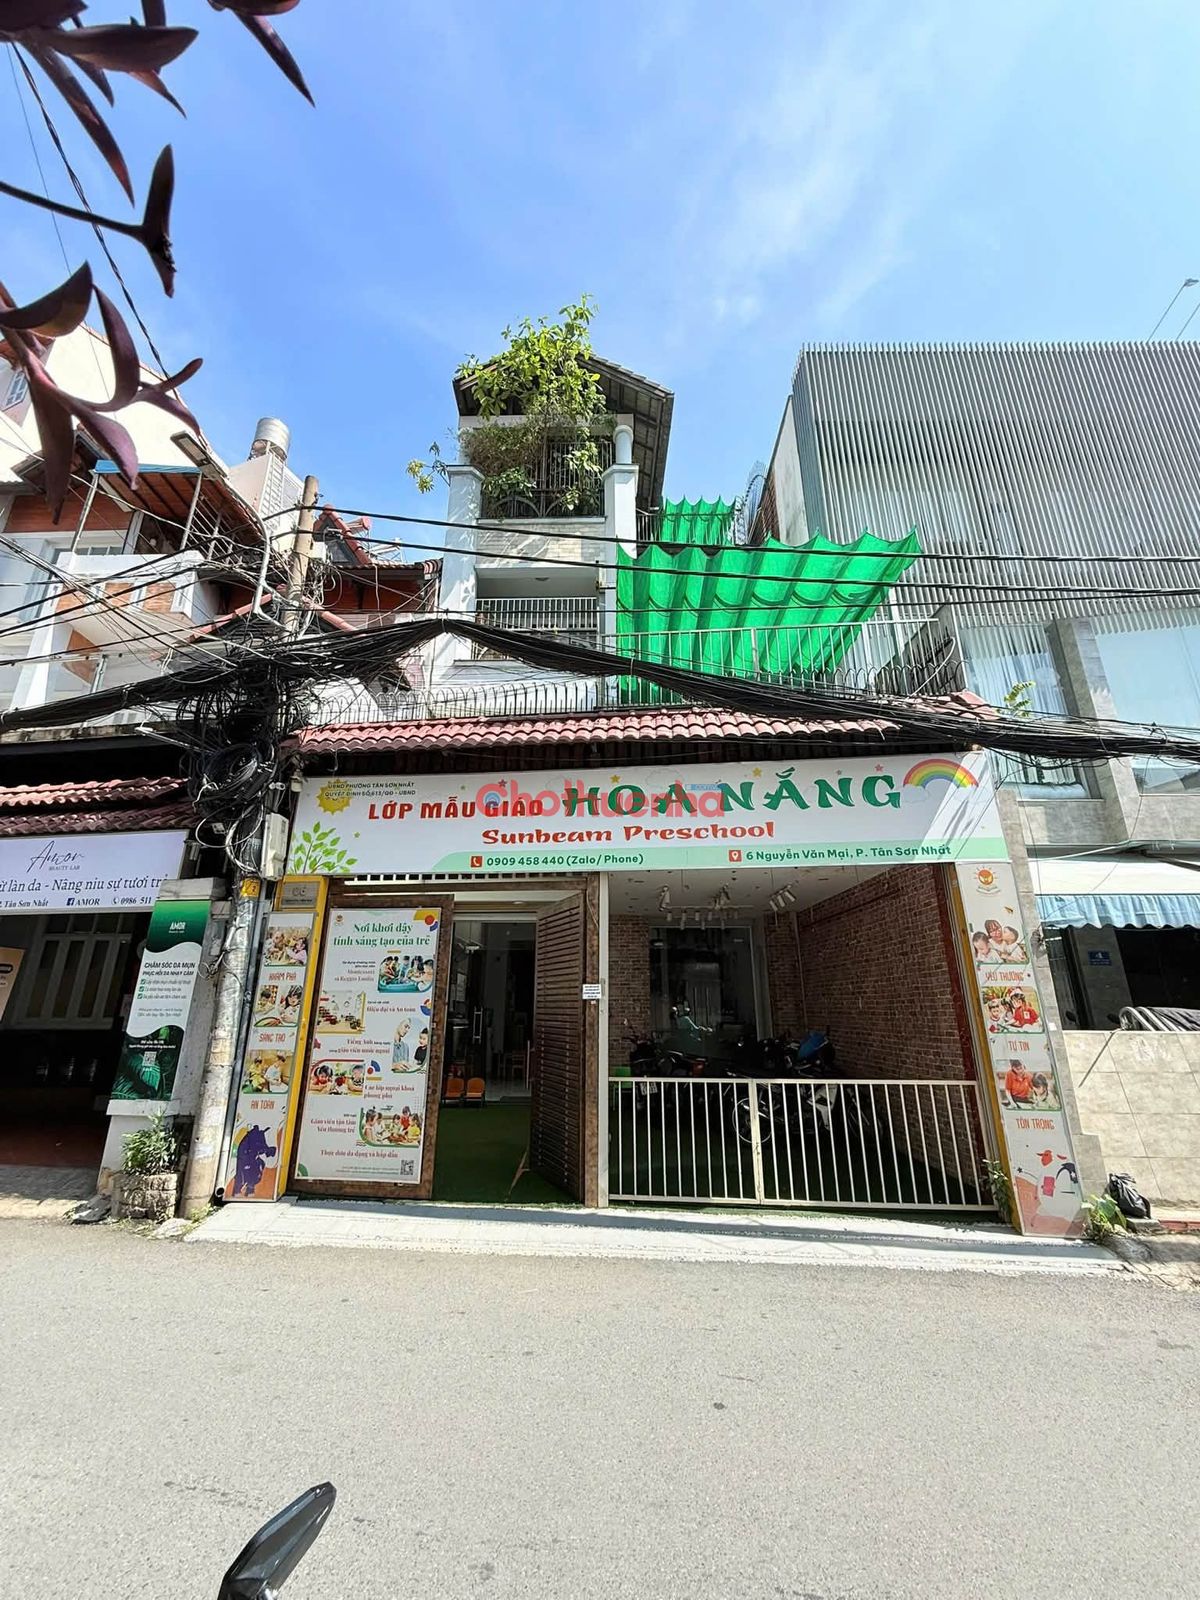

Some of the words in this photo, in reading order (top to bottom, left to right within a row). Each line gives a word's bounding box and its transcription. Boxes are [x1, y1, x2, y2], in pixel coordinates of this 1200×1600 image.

[562, 783, 697, 816] HOA
[718, 766, 901, 812] NẮNG
[368, 800, 413, 820] LỚP
[420, 796, 476, 818] MẪU
[484, 797, 543, 818] GIÁO
[482, 829, 612, 845] Sunbeam
[623, 822, 774, 841] Preschool
[746, 853, 754, 861] 6
[756, 849, 800, 862] Nguyễn
[801, 850, 825, 860] Văn
[856, 849, 868, 858] P.
[870, 847, 893, 857] Tân
[895, 847, 918, 857] Sơn
[921, 845, 951, 856] Nhất
[8, 879, 25, 892] làn
[28, 878, 41, 892] da
[51, 879, 83, 893] Nâng
[89, 877, 104, 891] niu
[107, 876, 121, 893] sự
[124, 875, 148, 889] tươi
[75, 898, 100, 906] AMOR
[121, 896, 137, 905] 0986
[354, 922, 370, 933] Nơi
[371, 922, 394, 933] khơi
[395, 922, 412, 935] dậy
[333, 935, 353, 946] tính
[355, 935, 378, 948] sáng
[379, 937, 395, 948] tạo
[396, 935, 414, 946] của
[1015, 1116, 1030, 1129] TÔN
